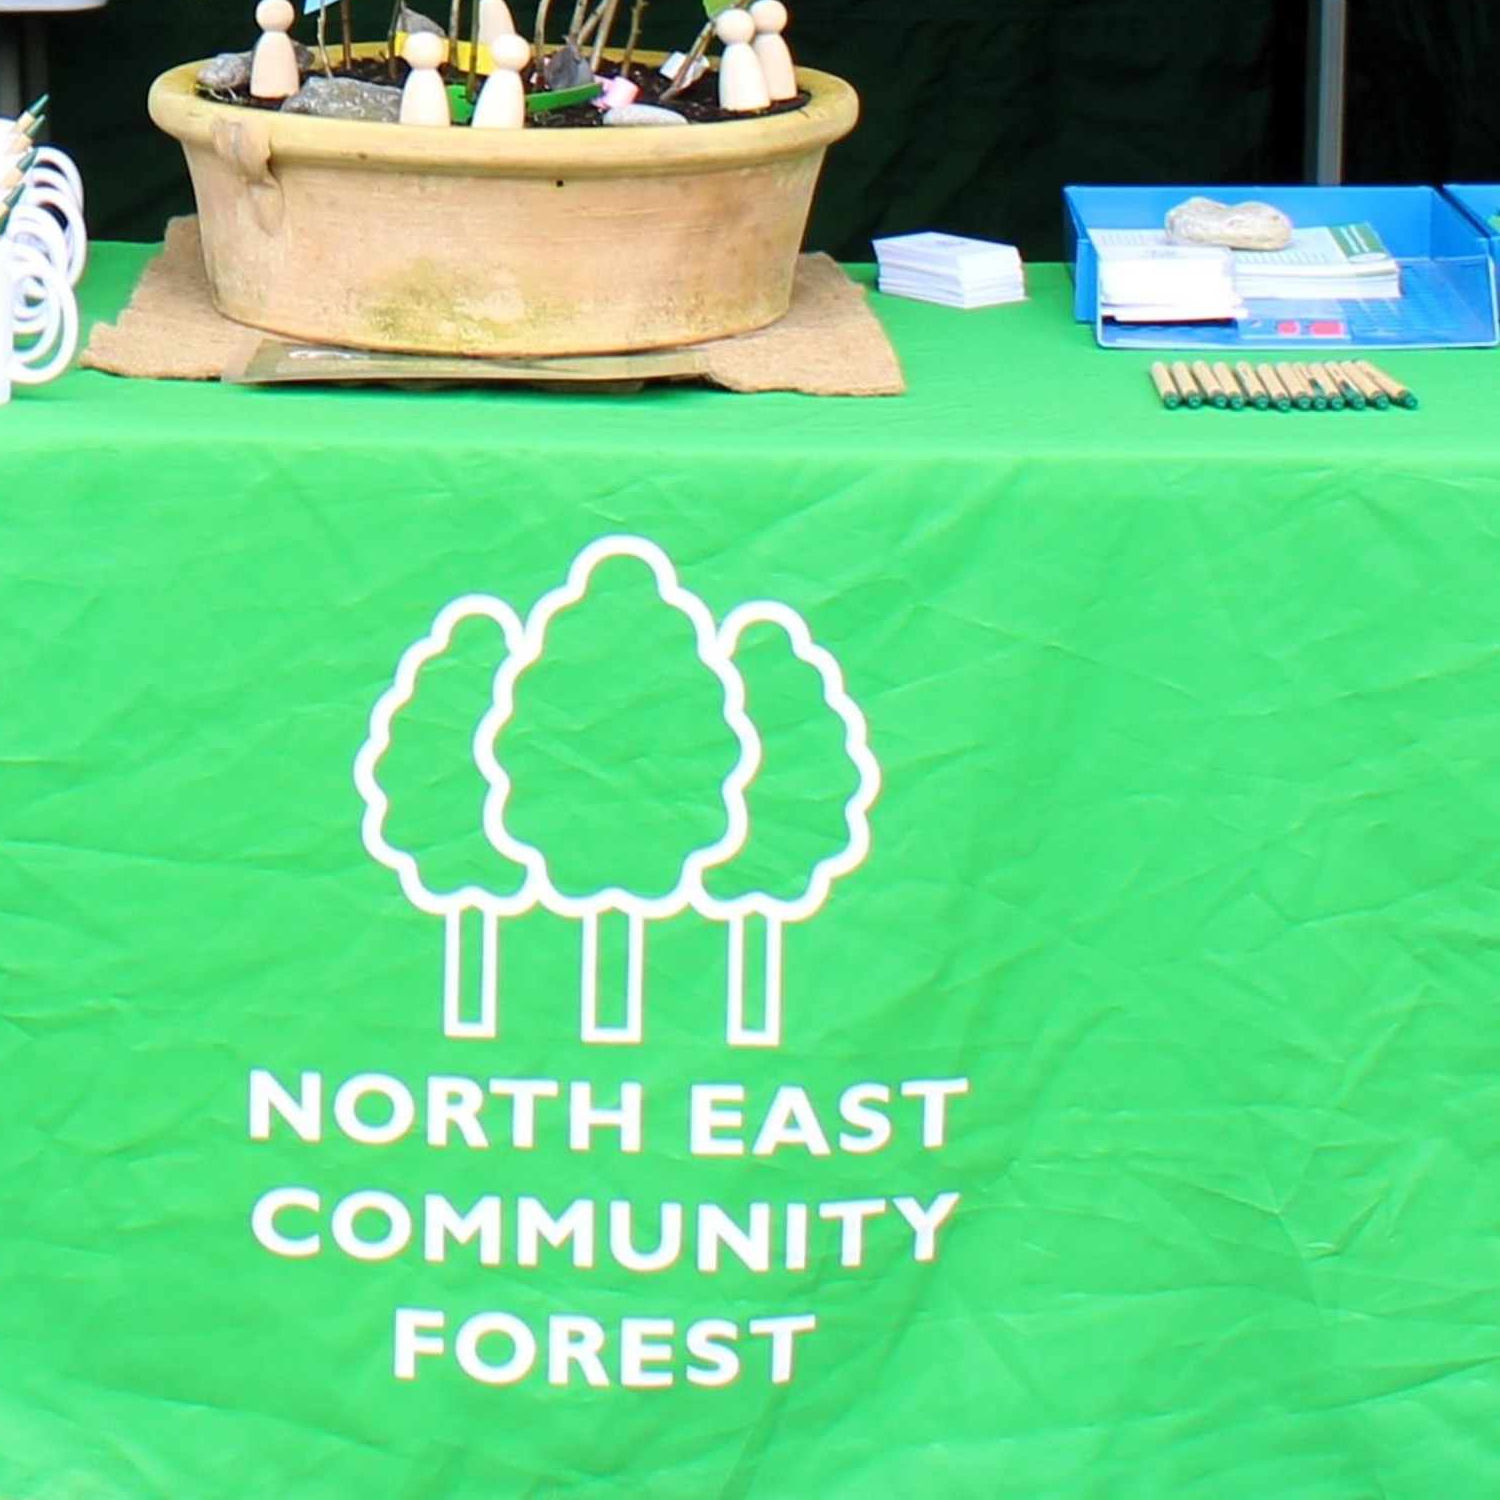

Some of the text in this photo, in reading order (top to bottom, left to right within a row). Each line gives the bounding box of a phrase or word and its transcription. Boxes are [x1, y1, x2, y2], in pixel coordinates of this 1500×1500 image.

[249, 1069, 969, 1156] NORTH EAST
[251, 1187, 961, 1273] COMMUNITY
[393, 1307, 817, 1388] FOREST
